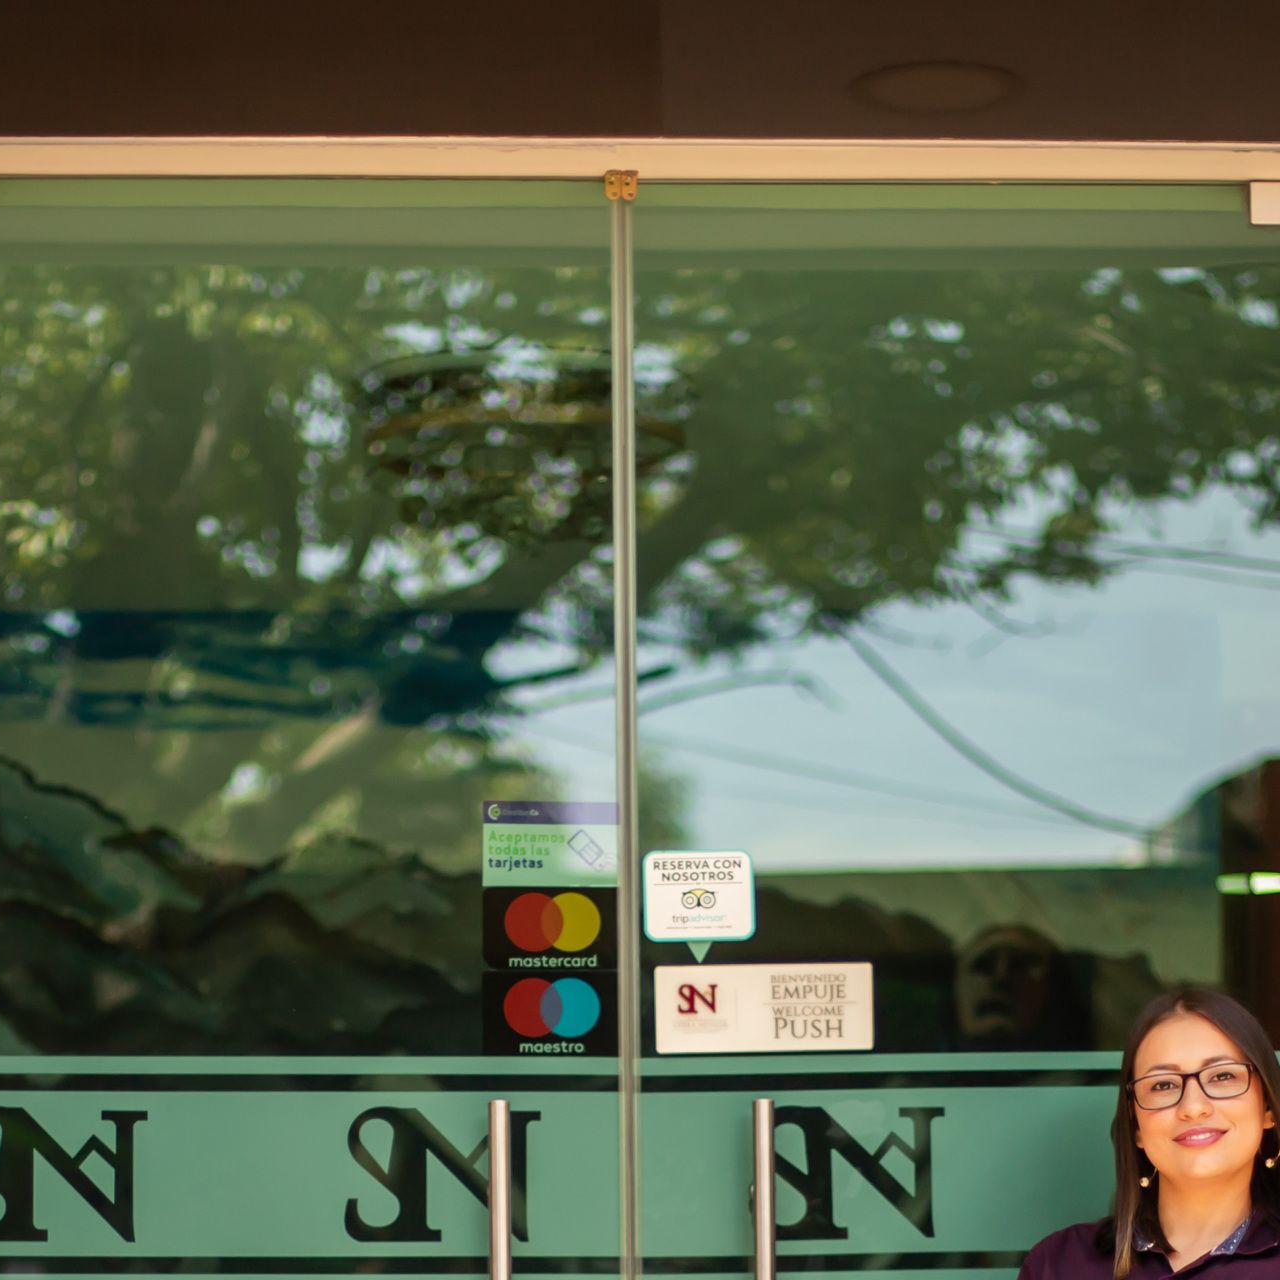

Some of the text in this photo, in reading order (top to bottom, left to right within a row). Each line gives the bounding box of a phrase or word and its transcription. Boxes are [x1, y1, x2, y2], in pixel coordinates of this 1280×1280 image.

[487, 830, 566, 846] Aceptamos
[488, 844, 551, 856] todas las
[487, 857, 544, 872] tarjetas
[653, 858, 742, 871] RESERVA CON
[661, 870, 735, 882] NOSOTROS
[508, 954, 598, 968] mastercard
[770, 973, 847, 984] BIENVENIDO
[771, 983, 847, 1002] EMPUJE
[771, 1004, 845, 1017] WELCOME
[773, 1016, 844, 1040] PUSH
[519, 1041, 585, 1054] maestro
